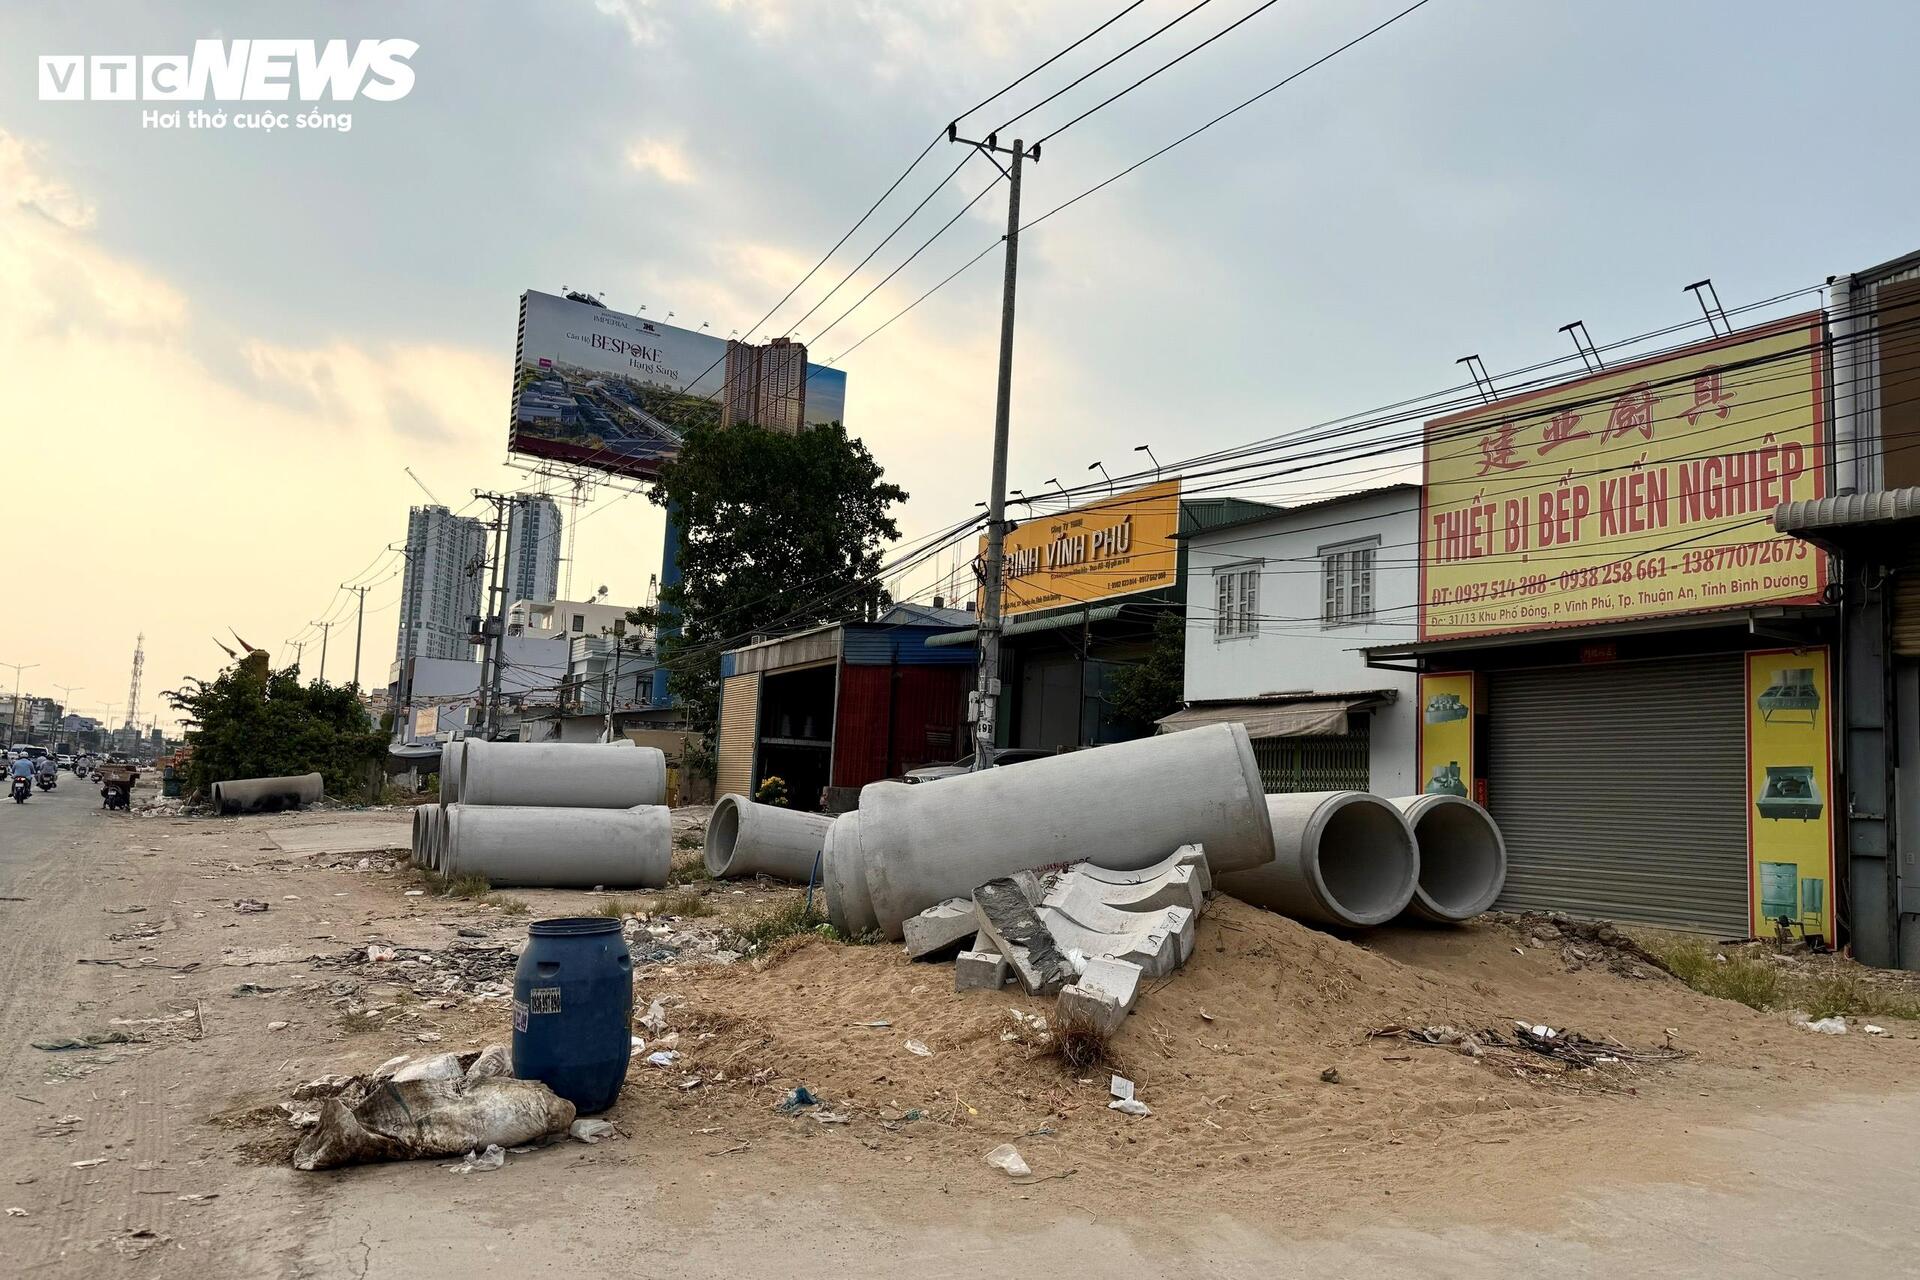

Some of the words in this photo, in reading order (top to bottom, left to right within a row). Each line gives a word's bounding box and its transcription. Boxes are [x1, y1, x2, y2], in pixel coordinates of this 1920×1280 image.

[592, 333, 663, 363] BESPOKE
[629, 358, 654, 374] Hạng
[656, 365, 679, 380] Sang
[1433, 487, 1497, 564] THIẾT
[1504, 496, 1530, 563] BỊ
[1538, 468, 1590, 547] BẾP
[1600, 452, 1668, 537] KIẾN
[1679, 432, 1804, 525] NGHIỆP
[1046, 532, 1085, 569] VĨNH
[1092, 514, 1131, 560] PHÚ
[1432, 588, 1452, 607] ĐT:
[1455, 583, 1488, 605] 0937
[1519, 573, 1547, 596] 388
[1560, 566, 1598, 591] 0938
[1603, 561, 1632, 586] 258
[1636, 556, 1668, 582] 661
[1682, 539, 1808, 575] 13877072673
[1449, 611, 1476, 625] 31/13
[1479, 609, 1496, 622] Khu
[1500, 604, 1518, 620] Phố
[1521, 605, 1551, 620] Đông,
[1553, 603, 1562, 613] P.
[1566, 598, 1587, 612] Vĩnh
[1591, 596, 1615, 609] Phú,
[1618, 595, 1635, 609] Tp.
[1638, 589, 1673, 606] Thuận
[1678, 586, 1697, 600] An,
[1701, 582, 1727, 596] Tỉnh
[1731, 579, 1758, 593] Bình
[1763, 574, 1808, 589] Dương
